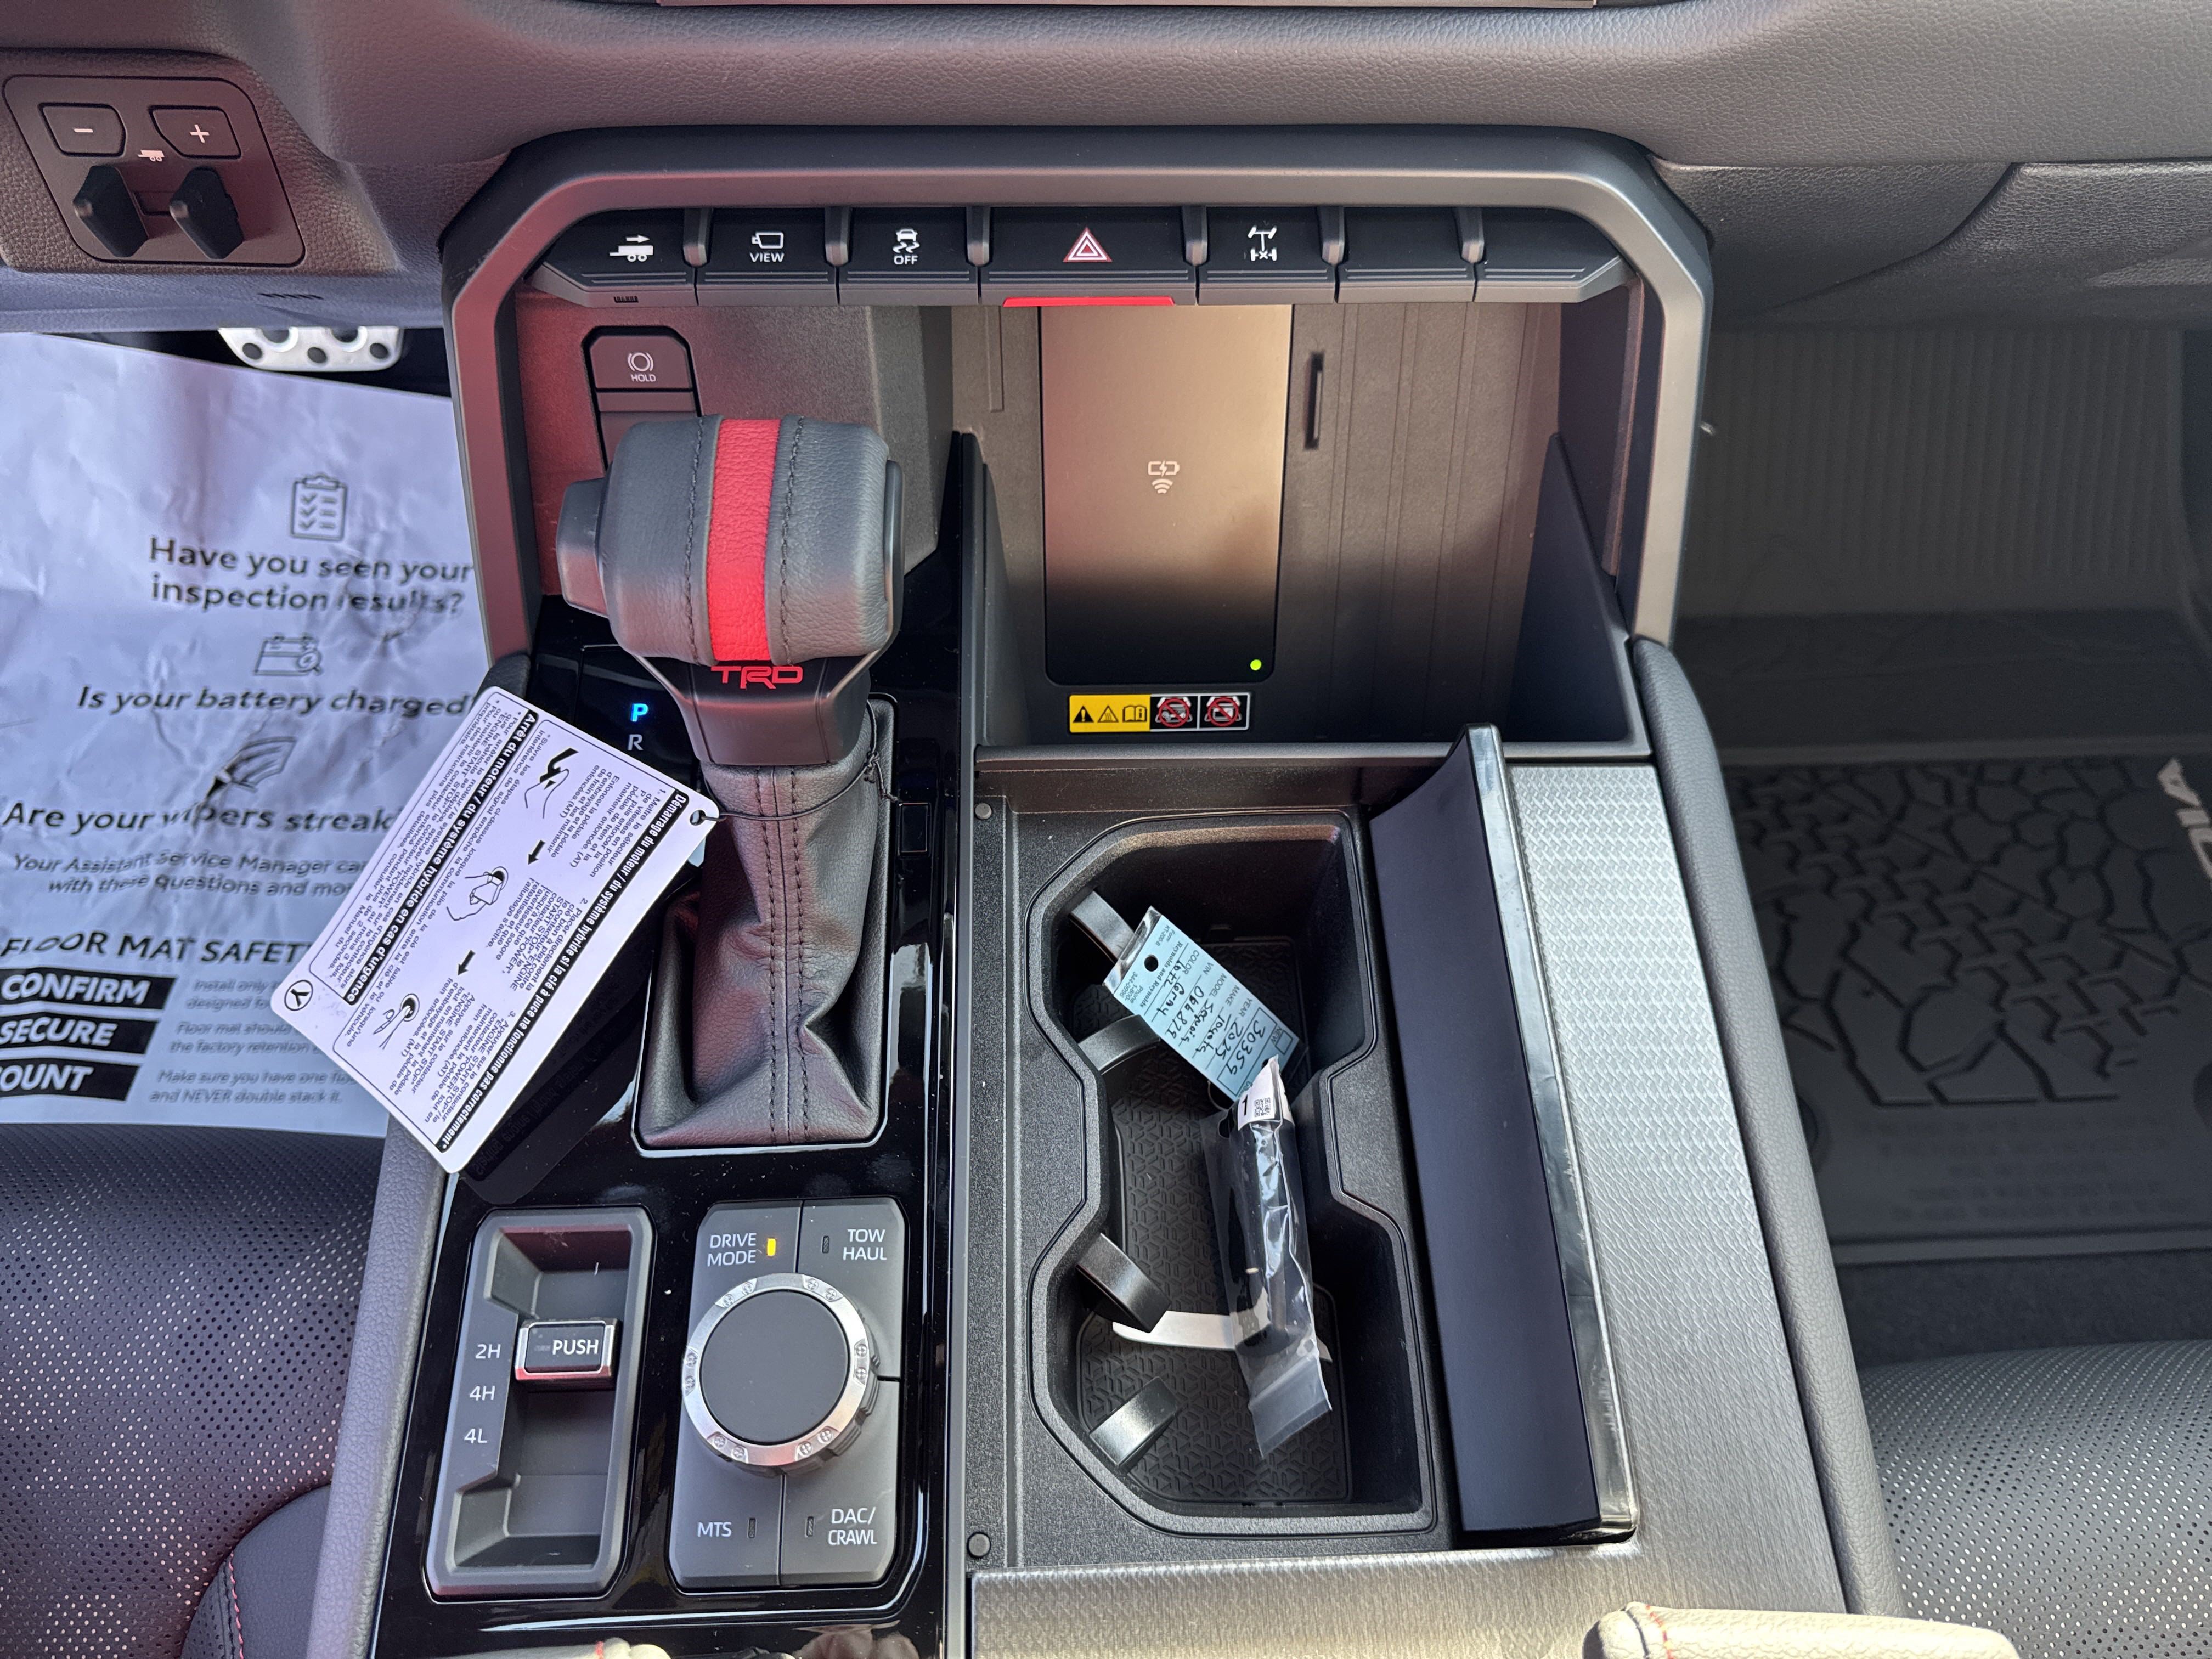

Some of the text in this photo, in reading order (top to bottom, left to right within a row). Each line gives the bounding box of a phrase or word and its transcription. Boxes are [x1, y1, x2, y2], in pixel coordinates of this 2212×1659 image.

[749, 252, 785, 263] VIEW
[893, 255, 918, 266] OFF
[631, 373, 656, 383] HOLD
[150, 535, 473, 584] Have you seen your
[151, 573, 328, 612] inspection
[710, 665, 803, 689] TRD
[77, 686, 103, 709] Is
[111, 690, 191, 714] your
[197, 687, 321, 715] battery
[630, 702, 649, 723] P
[513, 714, 535, 741] Arrêt
[503, 742, 516, 757] du
[628, 733, 643, 752] R
[478, 758, 506, 797] moteur
[619, 785, 639, 810] pédale
[462, 803, 476, 818] du
[610, 812, 619, 822] de
[624, 799, 637, 816] puis
[640, 797, 661, 820] Mettre
[649, 794, 686, 836] Démarrage
[4, 800, 64, 827] Are
[71, 809, 155, 837] your
[569, 782, 633, 867] maintenir enfoncée. (AT)
[433, 819, 465, 864] système
[590, 792, 652, 877] de vitesses en position
[597, 824, 612, 840] frein
[601, 817, 625, 849] enfoncer
[641, 836, 654, 847] du
[608, 832, 633, 866] sélecteur
[14, 853, 61, 872] Your
[63, 851, 153, 873] Assistant
[154, 849, 233, 868] Service
[238, 853, 332, 876] Manager
[621, 847, 645, 876] moteur
[48, 876, 93, 894] with
[154, 872, 262, 895] questions
[266, 879, 310, 896] and
[406, 866, 437, 907] hybride
[609, 879, 622, 891] du
[529, 891, 558, 934] contacteur
[544, 896, 563, 926] START
[562, 900, 571, 911] le
[586, 891, 613, 924] système
[396, 909, 408, 923] en
[562, 907, 582, 934] Placer
[379, 925, 398, 945] cas
[535, 909, 566, 953] contacteur
[566, 924, 592, 956] hybride
[1166, 929, 1175, 941] Form
[117, 934, 196, 961] MAT
[517, 902, 577, 989] clé bien à plat contre
[516, 958, 524, 969] le
[531, 934, 563, 983] directement
[560, 956, 569, 966] si
[1182, 950, 1199, 974] COLOR
[1203, 962, 1213, 974] VIN
[343, 943, 385, 1001] d'urgence
[554, 964, 566, 975] la
[1140, 941, 1183, 1007] Reynolds and Reynolds
[1, 973, 151, 1005] CONFIRM
[194, 979, 271, 994] Install only
[525, 983, 534, 991] la
[545, 975, 557, 990] clé
[1119, 972, 1137, 997] 344-0996
[1125, 984, 1137, 1000] 1-800-
[1209, 973, 1226, 996] MODEL
[290, 989, 310, 1007] Y
[1130, 985, 1143, 1003] Phone
[1225, 985, 1239, 1006] MAKE
[187, 997, 249, 1012] designed
[527, 994, 544, 1017] puce
[1238, 998, 1252, 1017] YEAR
[0, 1017, 118, 1046] SECURE
[177, 1022, 212, 1035] Floor
[216, 1022, 241, 1035] mat
[519, 1017, 530, 1029] ne
[1215, 1021, 1243, 1060] 2025
[1271, 1026, 1283, 1043] NEW
[169, 1039, 309, 1056] the factory retention
[487, 1028, 524, 1073] fonctionne
[0, 1063, 94, 1092] OUNT
[157, 1071, 196, 1084] Make
[199, 1073, 229, 1084] sure
[232, 1074, 259, 1086] you
[262, 1071, 293, 1084] have
[297, 1074, 327, 1085] one
[476, 1069, 494, 1090] pas
[150, 1089, 179, 1103] and
[183, 1090, 232, 1103] NEVER
[235, 1090, 285, 1104] double
[287, 1090, 325, 1104] stack
[709, 1233, 758, 1249] DRIVE
[848, 1228, 887, 1243] TOW
[707, 1249, 757, 1267] MODE
[842, 1246, 888, 1262] HAUL
[475, 1344, 501, 1359] 2H
[552, 1339, 599, 1355] PUSH
[469, 1385, 495, 1401] 4H
[464, 1428, 488, 1444] 4L
[831, 1507, 876, 1526] DAC/
[697, 1521, 732, 1538] MTS
[827, 1528, 878, 1545] CRAWL
